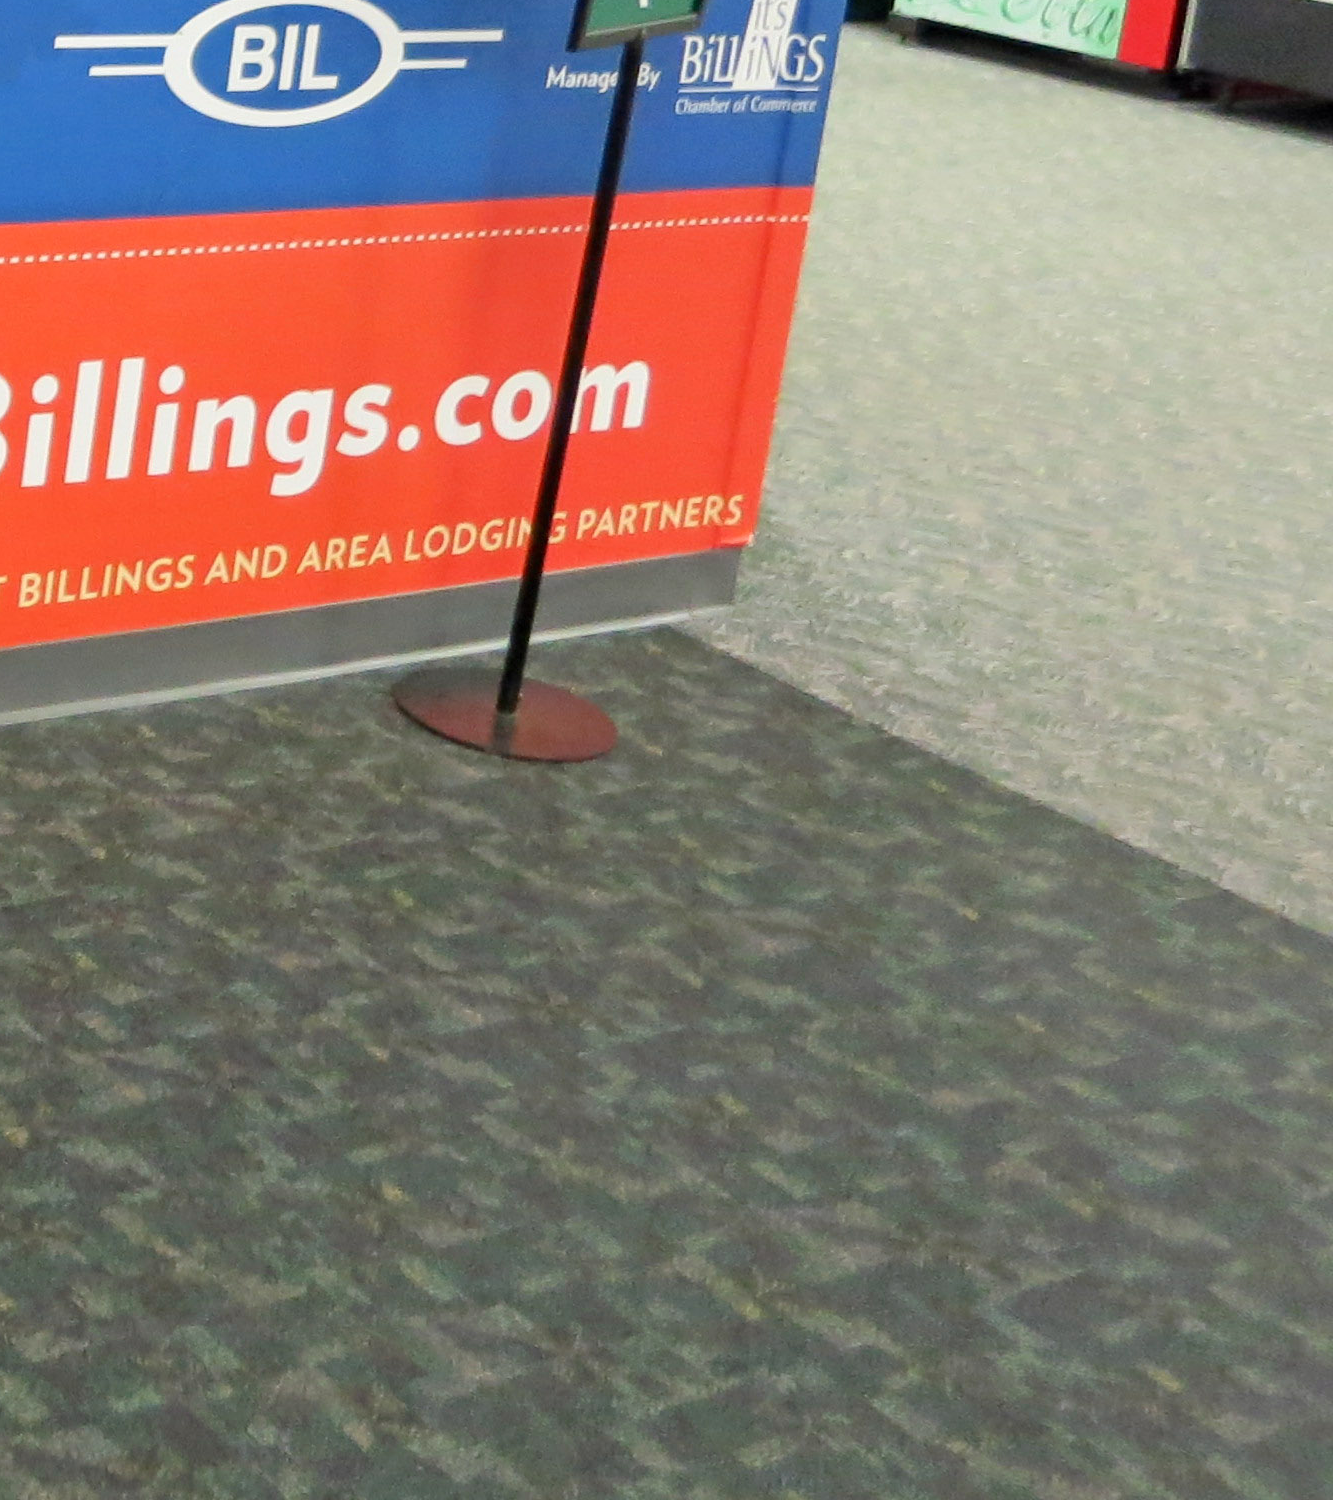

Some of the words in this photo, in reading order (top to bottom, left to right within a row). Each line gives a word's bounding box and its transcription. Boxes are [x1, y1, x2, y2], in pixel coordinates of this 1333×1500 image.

[226, 24, 339, 92] BIL
[545, 65, 619, 94] Manage
[636, 62, 661, 91] By
[675, 97, 729, 115] Chamber
[733, 95, 749, 113] of
[750, 96, 817, 113] Commerce
[17, 555, 195, 608] BILLINGS
[203, 540, 288, 586] AND
[295, 532, 393, 575] AREA
[576, 493, 745, 541] PARTNERS
